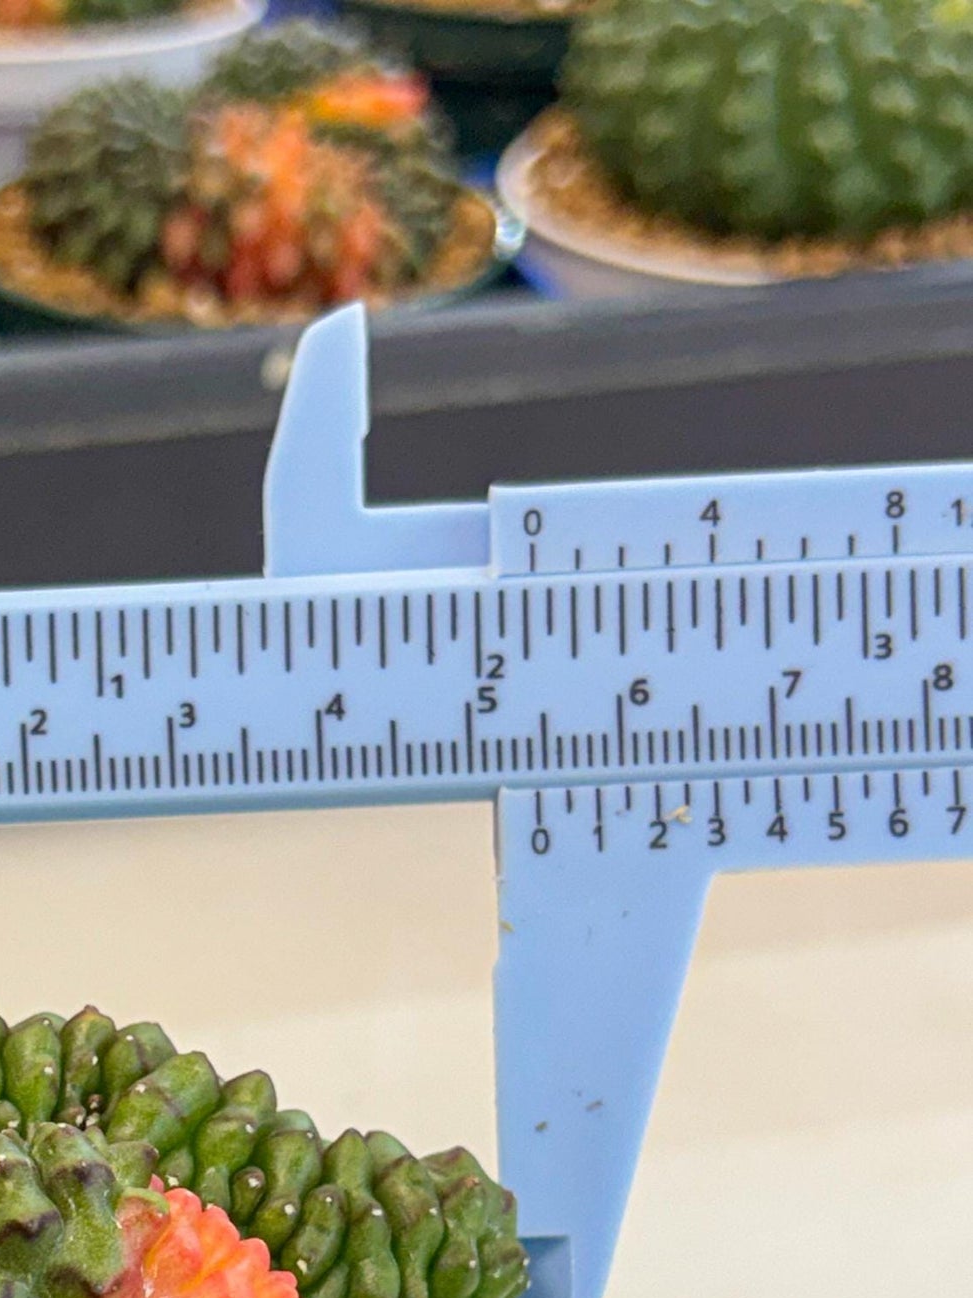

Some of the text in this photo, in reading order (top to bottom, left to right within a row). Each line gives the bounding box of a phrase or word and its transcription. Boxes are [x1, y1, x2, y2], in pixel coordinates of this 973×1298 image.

[523, 490, 973, 536] 0 4 8 1
[110, 675, 125, 698] 1
[486, 654, 505, 679] 2
[873, 634, 893, 660] 3
[30, 709, 48, 735] 2
[179, 702, 196, 728] 3
[325, 693, 345, 721] 4
[477, 686, 498, 713] 5
[629, 678, 649, 706] 6
[782, 671, 802, 699] 7
[932, 664, 953, 690] 8
[531, 807, 966, 855] 0 1 2 3 4 5 6 7
